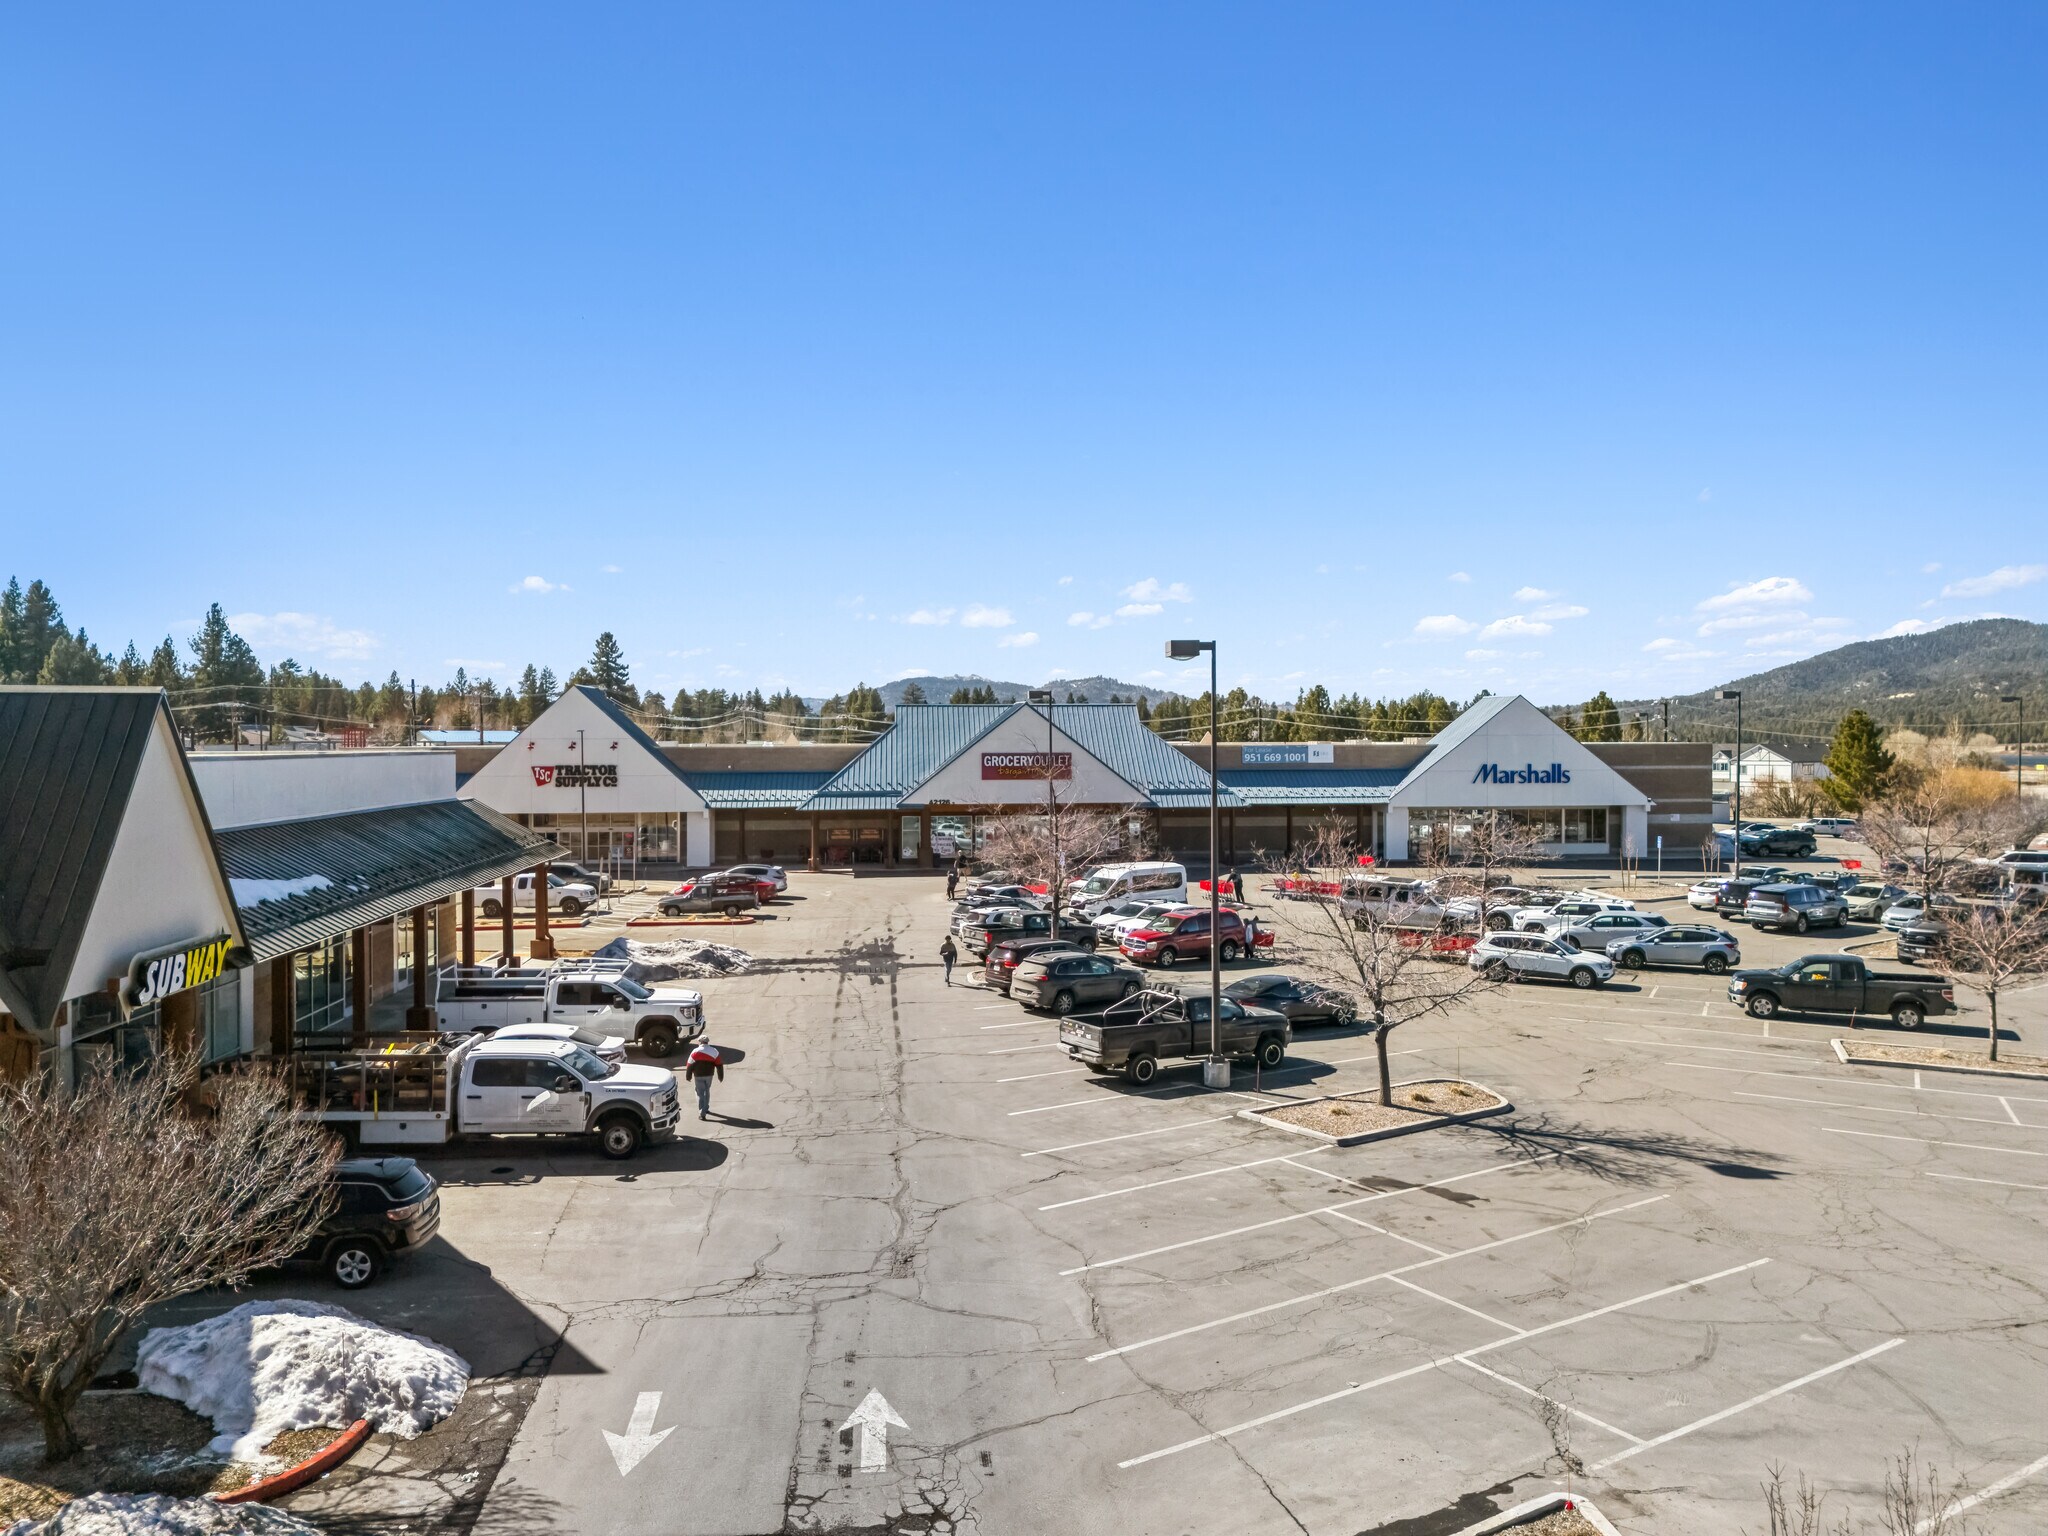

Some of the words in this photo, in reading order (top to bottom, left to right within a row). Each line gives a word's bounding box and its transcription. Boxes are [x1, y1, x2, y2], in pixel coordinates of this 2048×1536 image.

[1244, 753, 1261, 762] 951
[1264, 753, 1281, 762] 669
[1284, 753, 1306, 762] 1001
[534, 767, 551, 783] TSC
[555, 765, 618, 776] TRACTOR
[1472, 763, 1571, 784] Marshalls
[555, 776, 602, 787] SUPPLY
[139, 938, 234, 1005] SUBWAY
